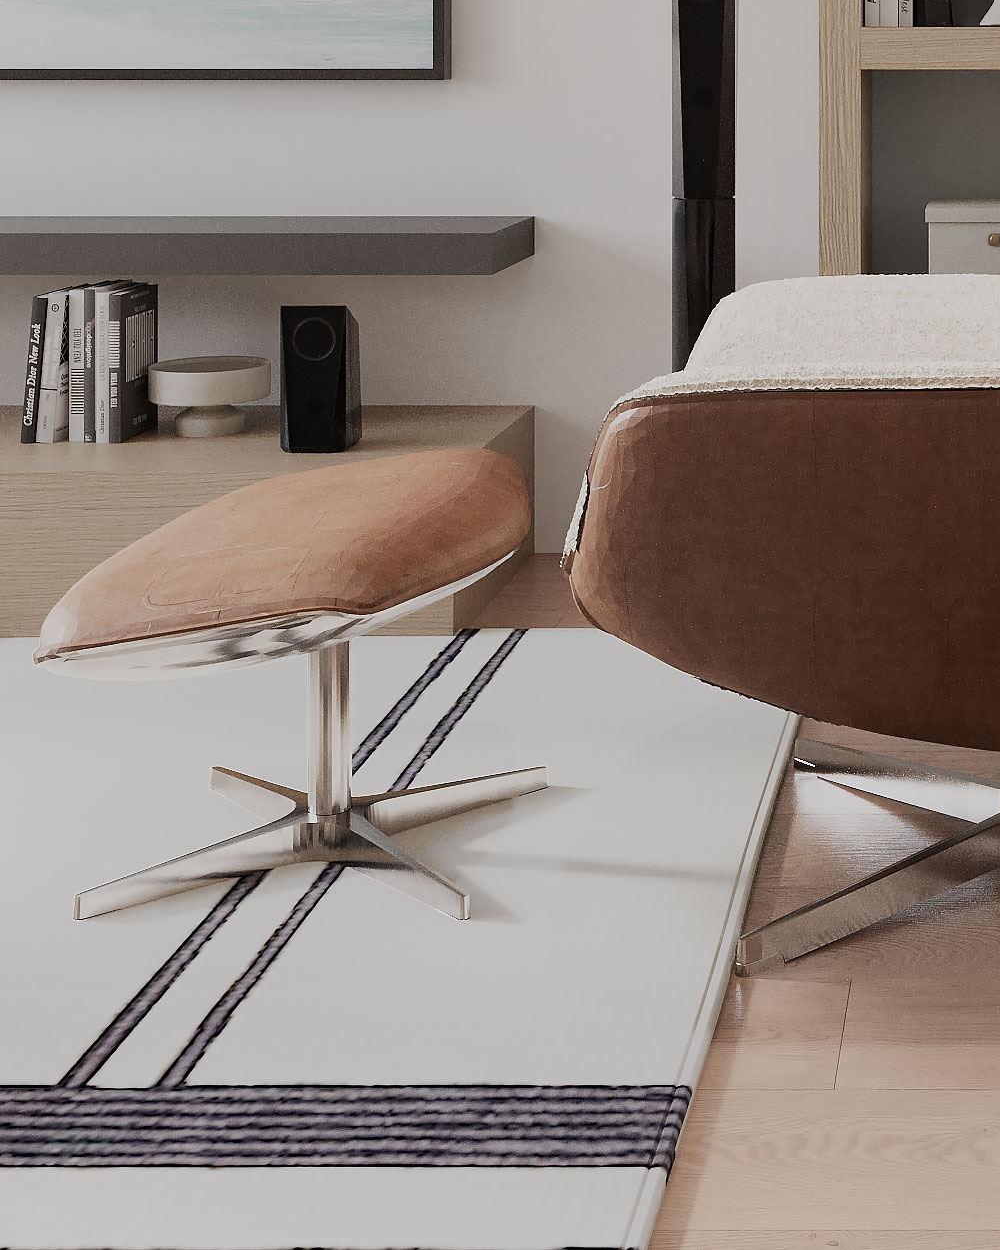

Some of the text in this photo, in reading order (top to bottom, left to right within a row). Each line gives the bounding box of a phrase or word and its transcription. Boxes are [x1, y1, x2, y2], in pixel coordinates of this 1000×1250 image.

[23, 323, 41, 426] Christian Dior New Look
